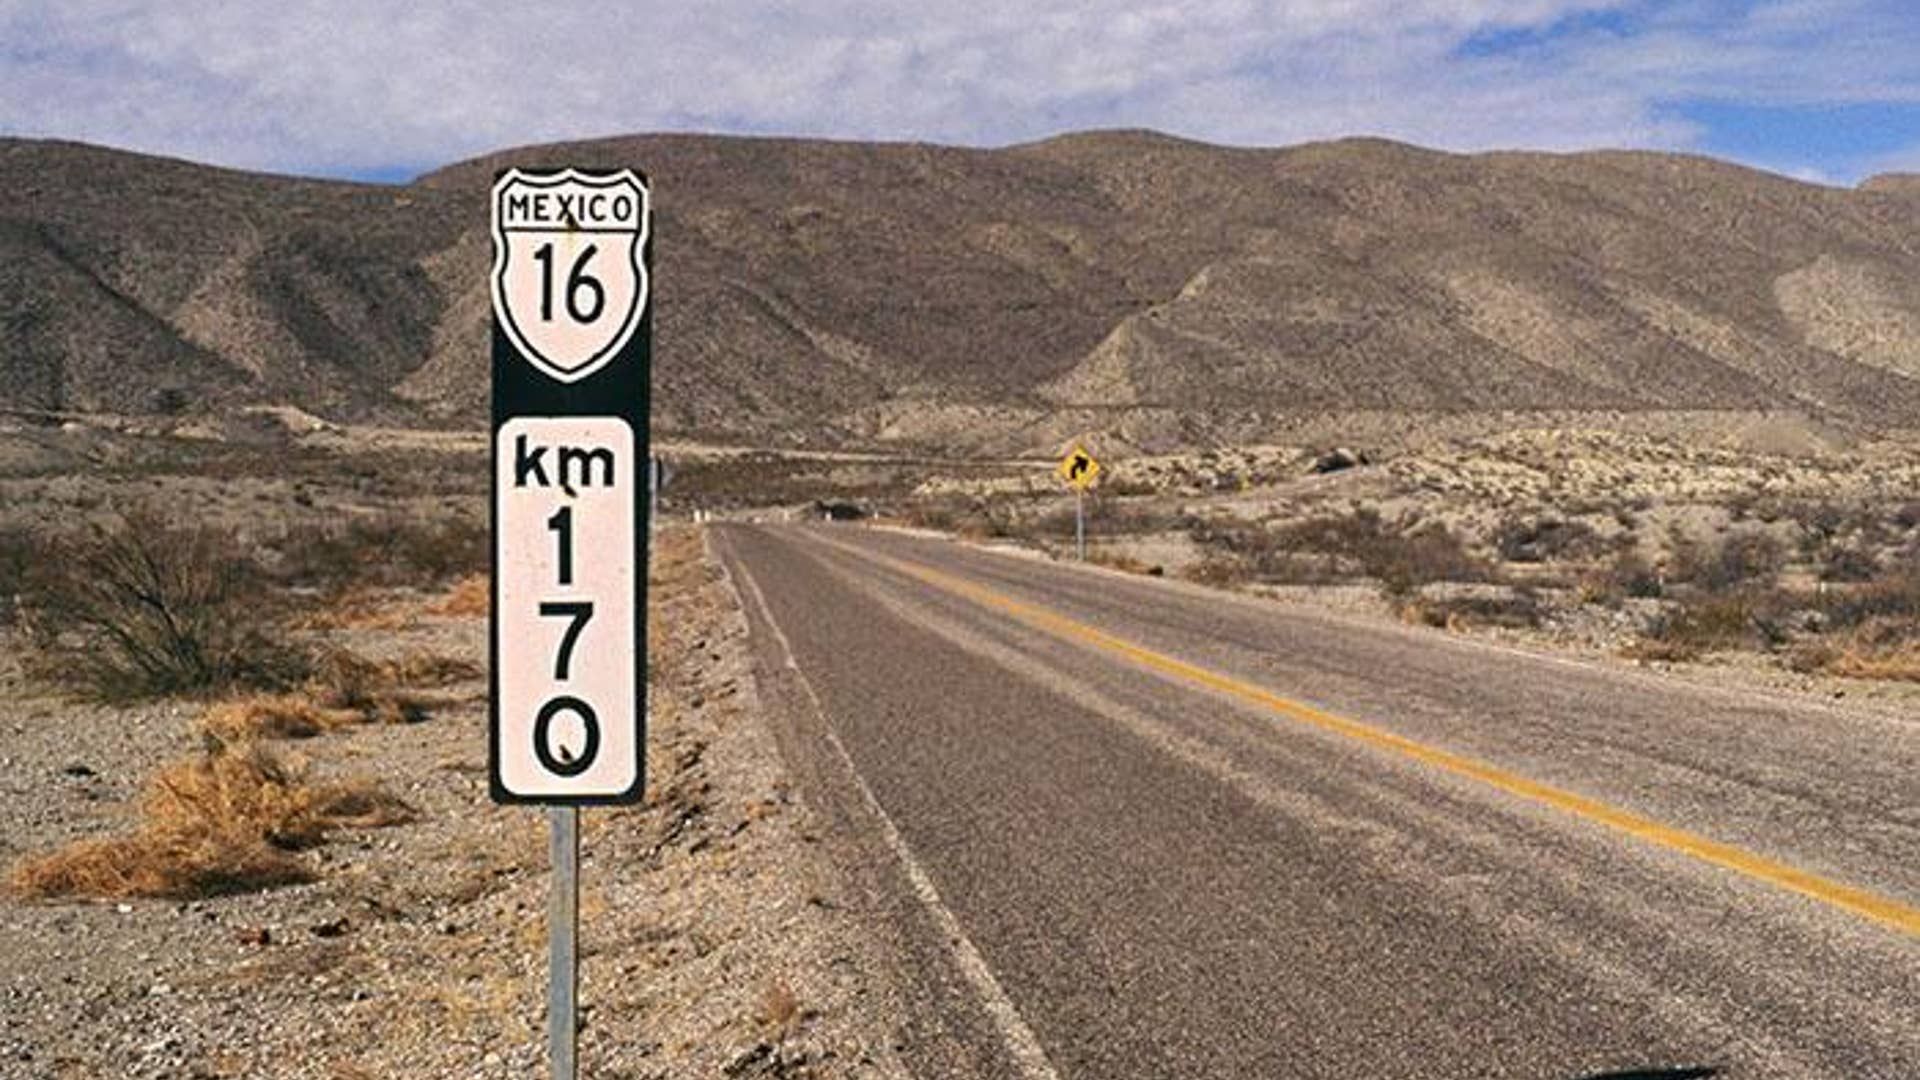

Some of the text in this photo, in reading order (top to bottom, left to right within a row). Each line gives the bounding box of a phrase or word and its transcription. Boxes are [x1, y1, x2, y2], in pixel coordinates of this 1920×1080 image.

[509, 194, 632, 221] MEXICO
[534, 243, 605, 324] 16
[514, 434, 615, 488] km
